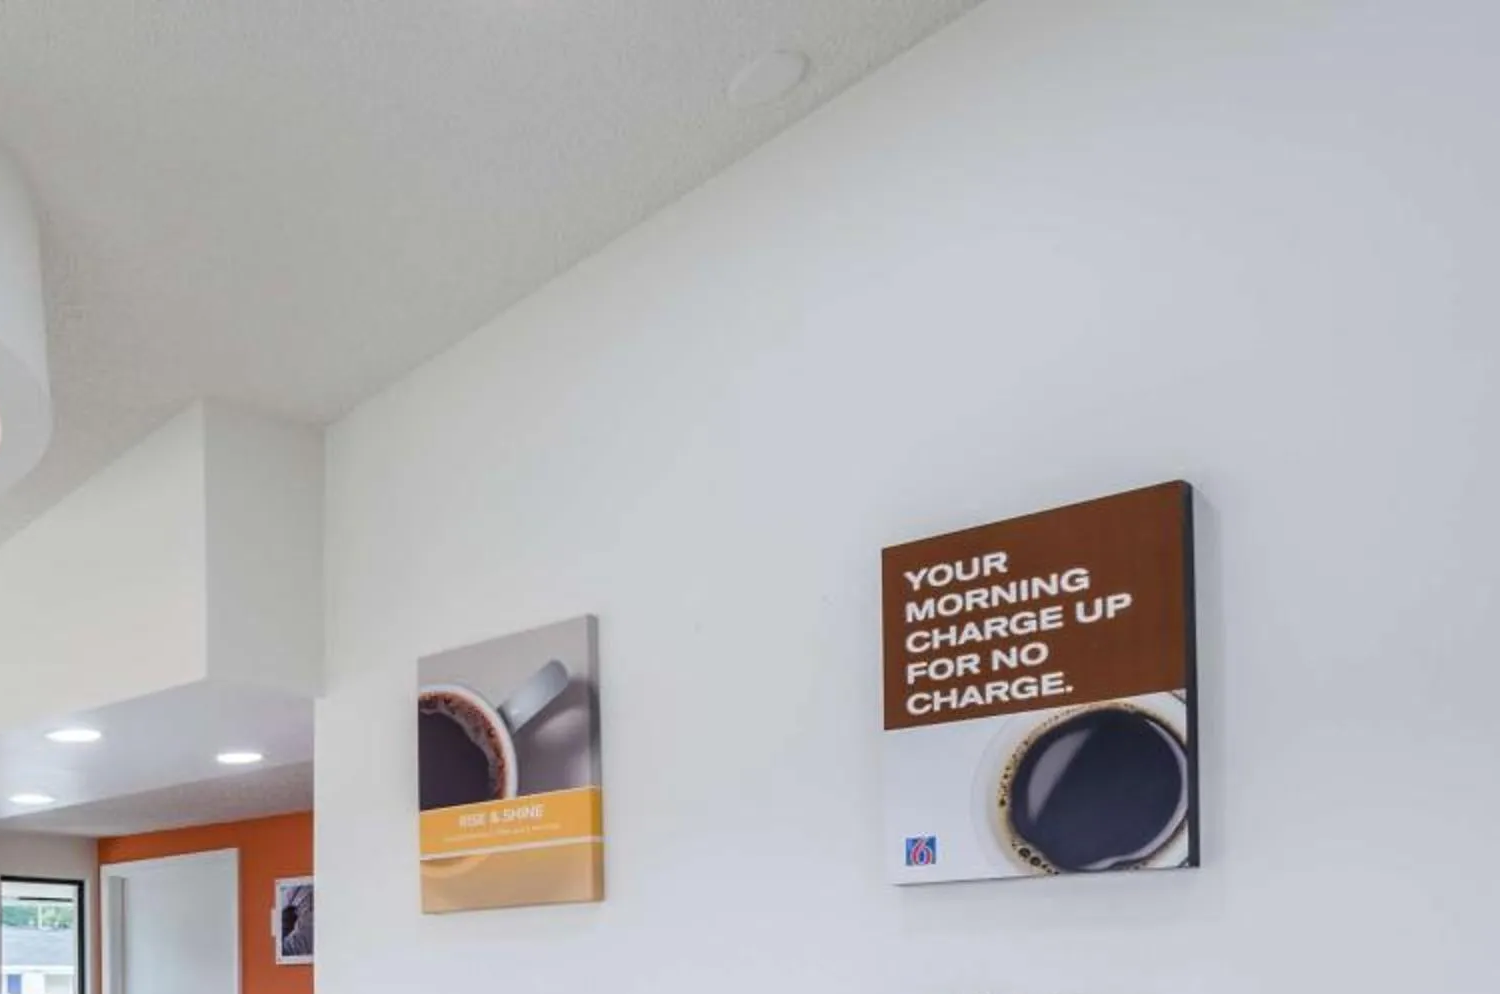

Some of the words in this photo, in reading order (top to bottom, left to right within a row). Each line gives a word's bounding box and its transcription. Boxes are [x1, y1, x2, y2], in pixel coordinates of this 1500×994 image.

[903, 551, 1008, 591] YOUR
[905, 567, 1091, 623] MORNING
[905, 605, 1064, 653] CHARGE
[1074, 592, 1133, 624] UP
[906, 653, 981, 684] FOR
[991, 641, 1049, 671] NO
[906, 671, 1074, 716] CHARGE.
